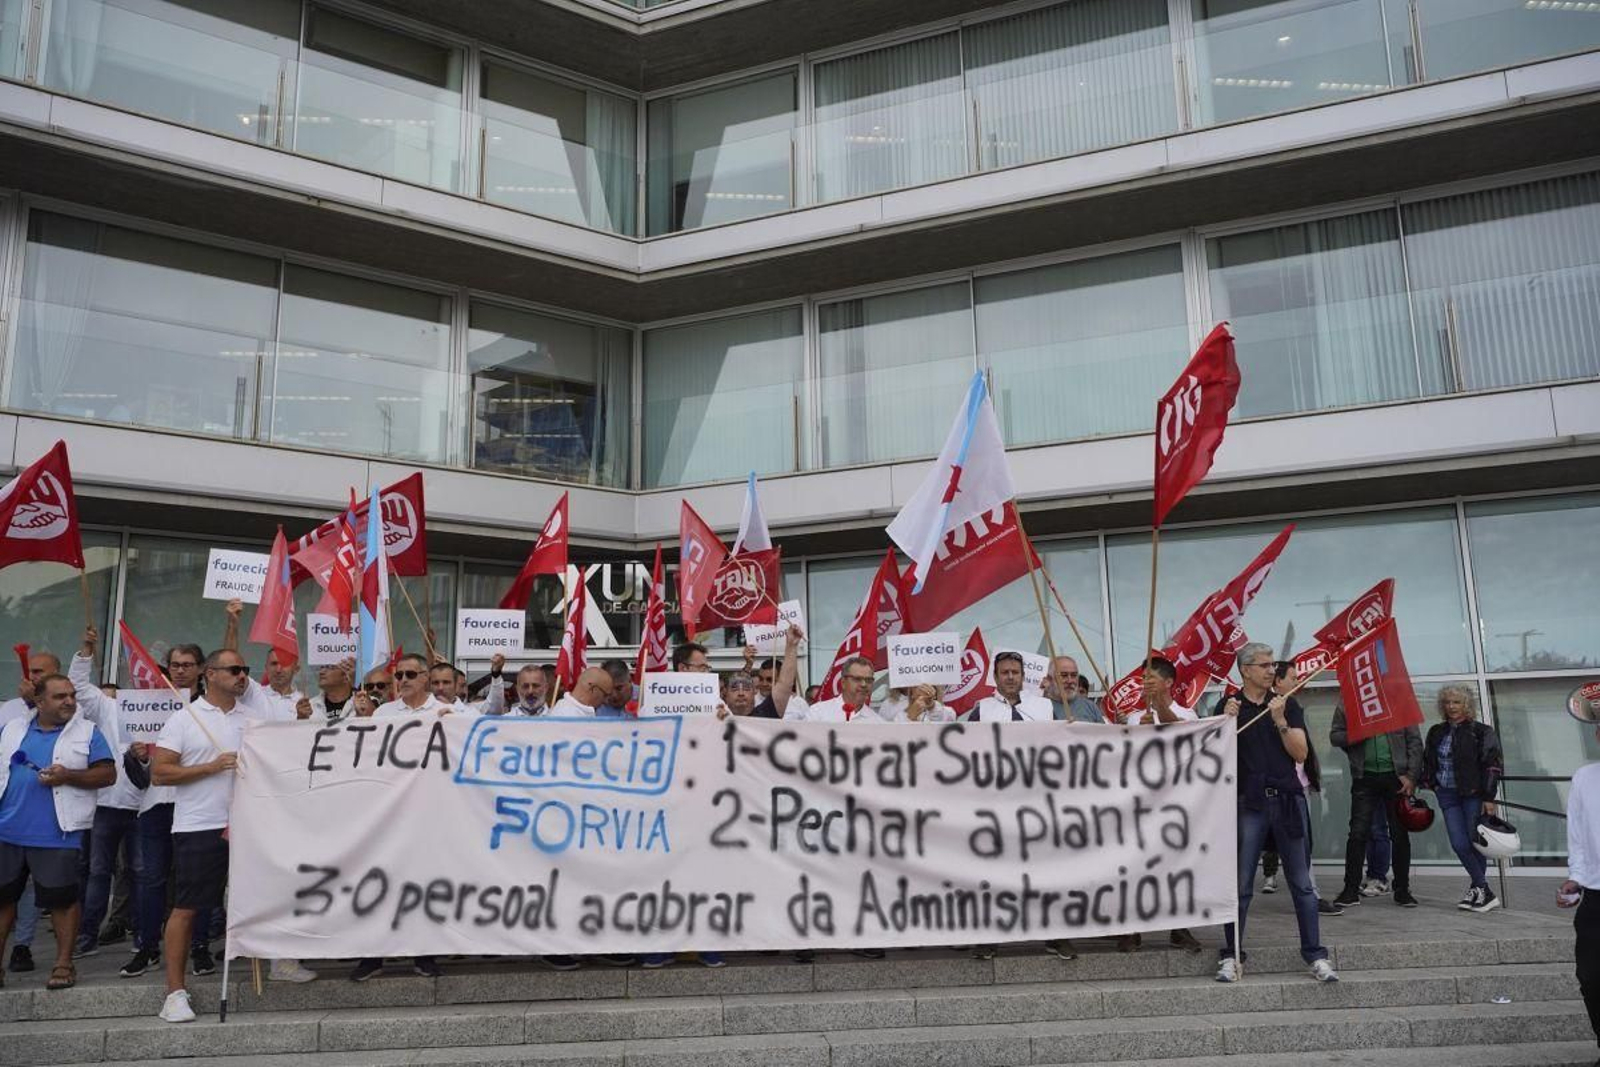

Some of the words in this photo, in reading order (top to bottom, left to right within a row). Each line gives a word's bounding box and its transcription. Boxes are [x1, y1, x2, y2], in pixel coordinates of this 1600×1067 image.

[215, 580, 254, 592] FRAUDE
[602, 602, 621, 613] DE
[462, 616, 519, 629] faurecia
[468, 638, 507, 646] FRAUDE
[892, 642, 954, 656] faurecia
[648, 682, 714, 695] faurecia
[1353, 650, 1383, 718] CCOO
[653, 703, 702, 714] SOLUCIÓN
[126, 723, 165, 733] FRAUD
[308, 718, 450, 771] ÉTICA
[490, 796, 671, 853] FORVIA
[968, 808, 1004, 860] a
[1015, 792, 1209, 862] planta.
[390, 867, 560, 931] persoal
[787, 873, 836, 938] da
[853, 856, 1211, 936] Administración.
